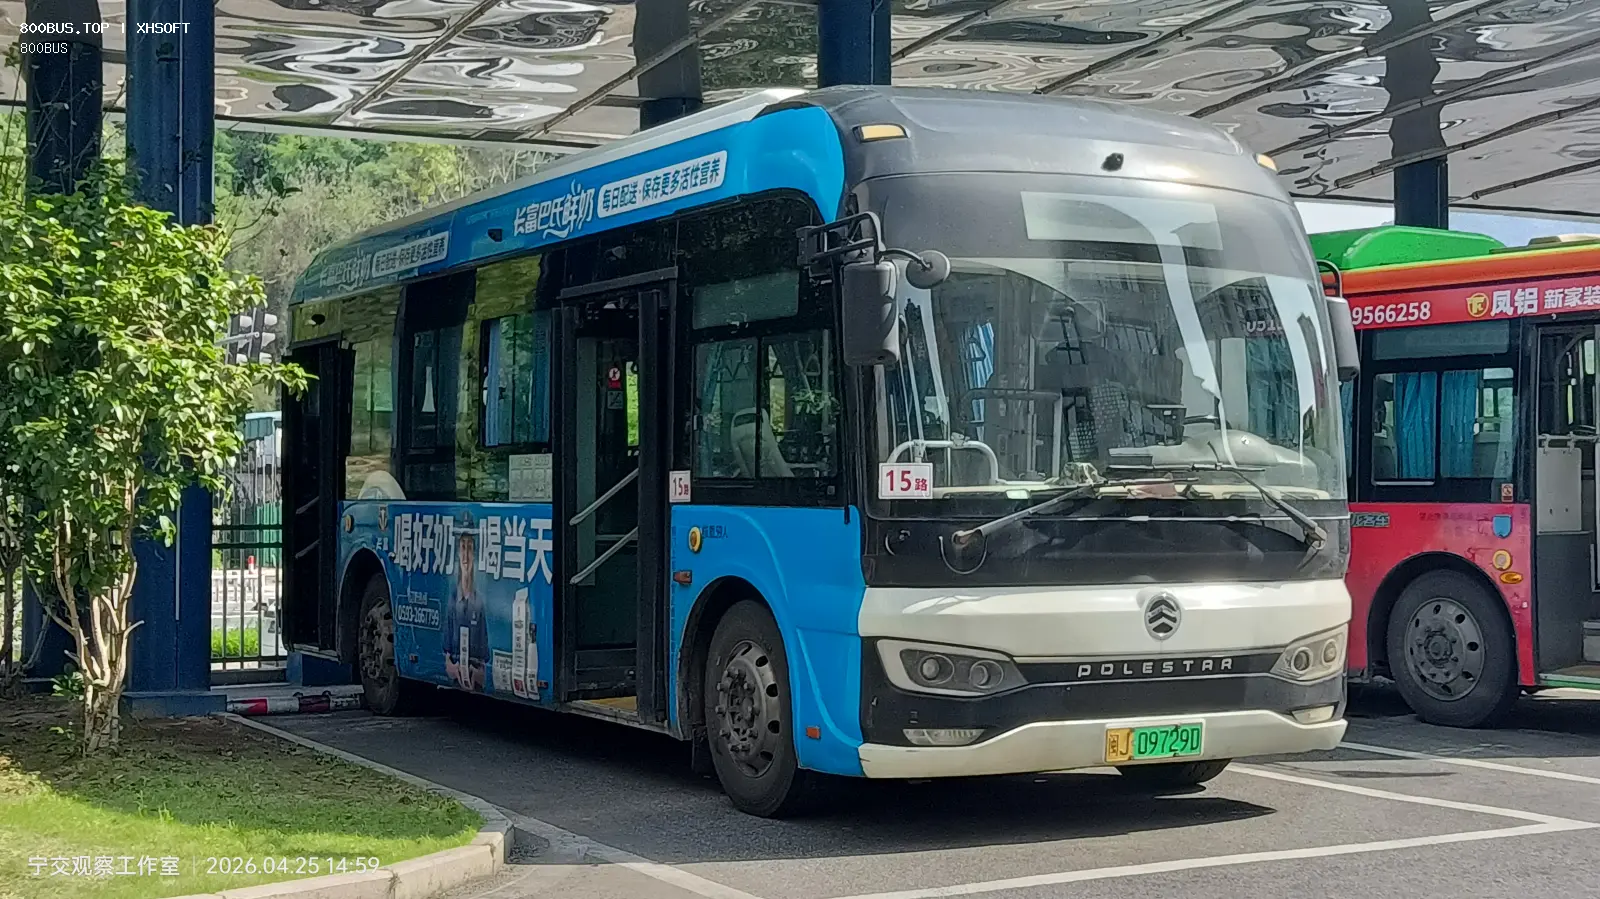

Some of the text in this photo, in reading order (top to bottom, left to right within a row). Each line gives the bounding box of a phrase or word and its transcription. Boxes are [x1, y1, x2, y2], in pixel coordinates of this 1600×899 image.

[513, 179, 595, 239] 长富巴氏鲜奶
[1490, 287, 1539, 316] 凤铝
[886, 469, 928, 492] 15路
[394, 513, 553, 584] 喝好奶 喝当天
[1077, 658, 1233, 678] POLESTAR
